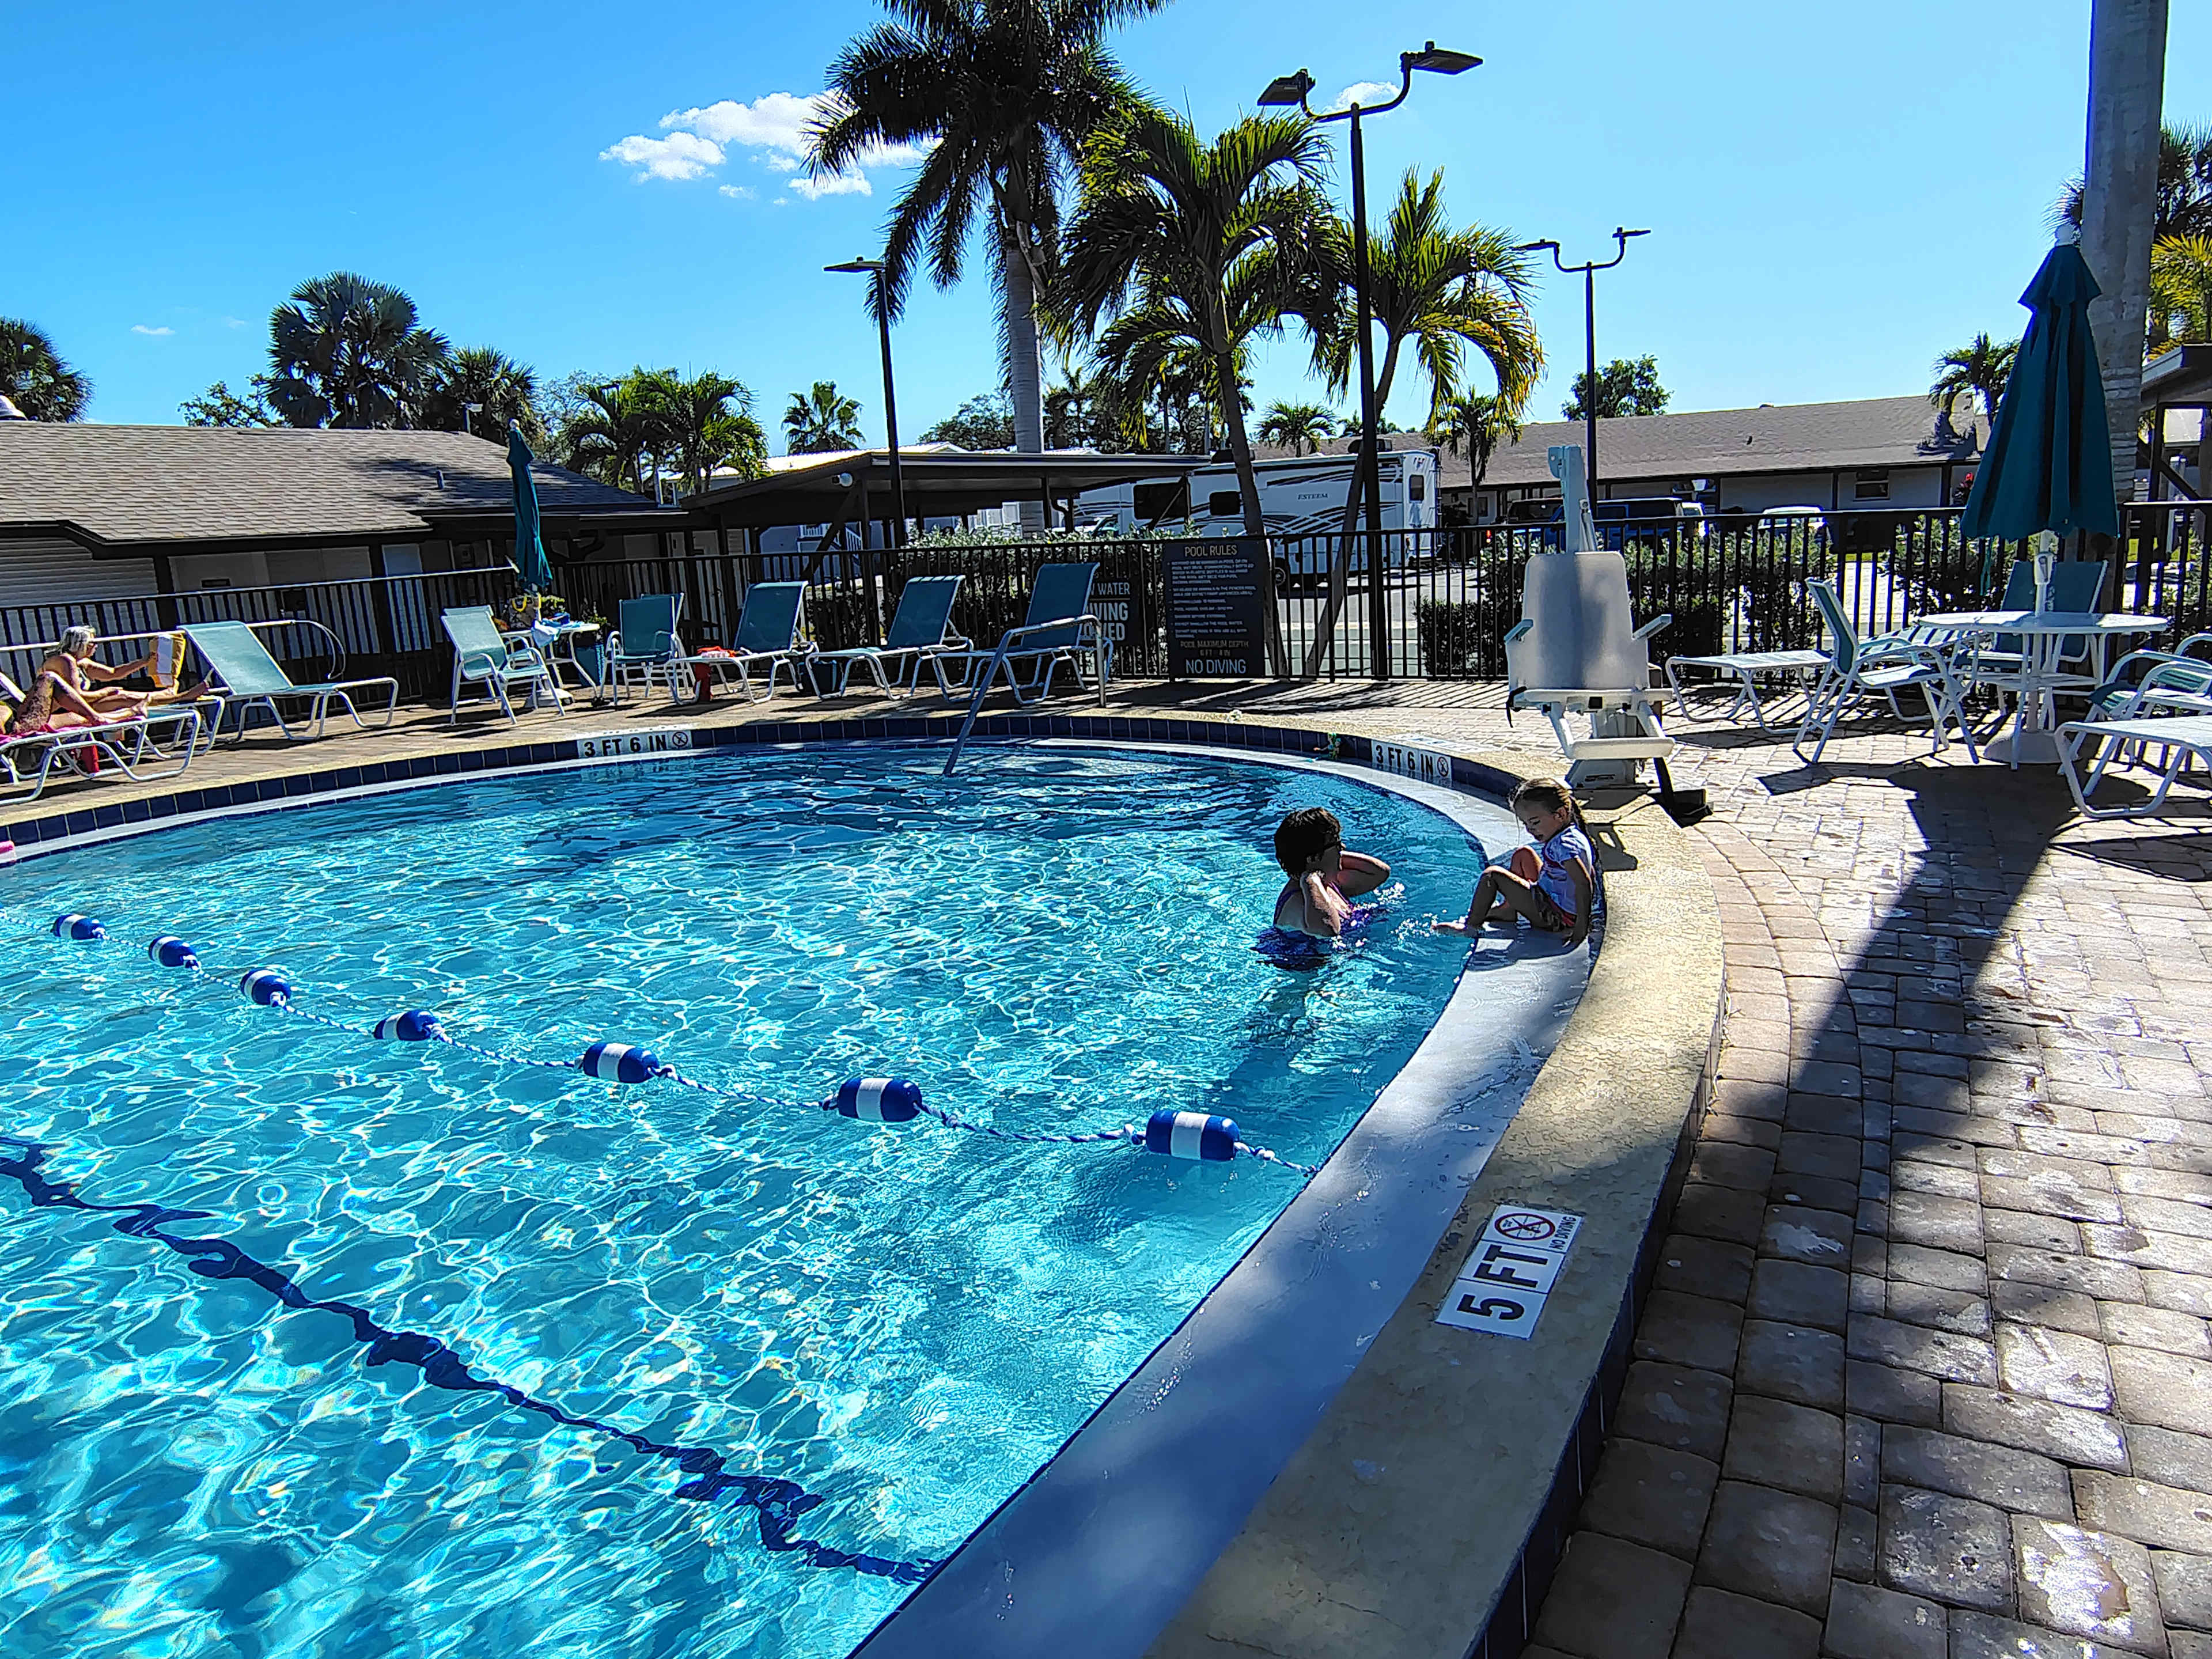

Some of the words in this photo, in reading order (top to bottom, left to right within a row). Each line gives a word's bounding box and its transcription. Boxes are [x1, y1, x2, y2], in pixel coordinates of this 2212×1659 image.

[1184, 546, 1208, 557] POOL
[1210, 544, 1237, 556] RULES
[1097, 582, 1130, 595] WATER
[1086, 602, 1128, 621] IVING
[1185, 659, 1203, 674] NO
[1206, 658, 1247, 674] DIVING
[584, 741, 596, 757] 3
[602, 738, 622, 756] FT
[630, 737, 641, 753] 6
[649, 734, 668, 752] IN
[1376, 745, 1384, 763] 3
[1388, 747, 1402, 768] FT
[1407, 751, 1415, 770] 6
[1421, 753, 1434, 775] IN
[1554, 1216, 1577, 1239] DIVING
[1549, 1239, 1566, 1250] NO
[1472, 1244, 1549, 1288] FT
[1456, 1294, 1525, 1320] 5
